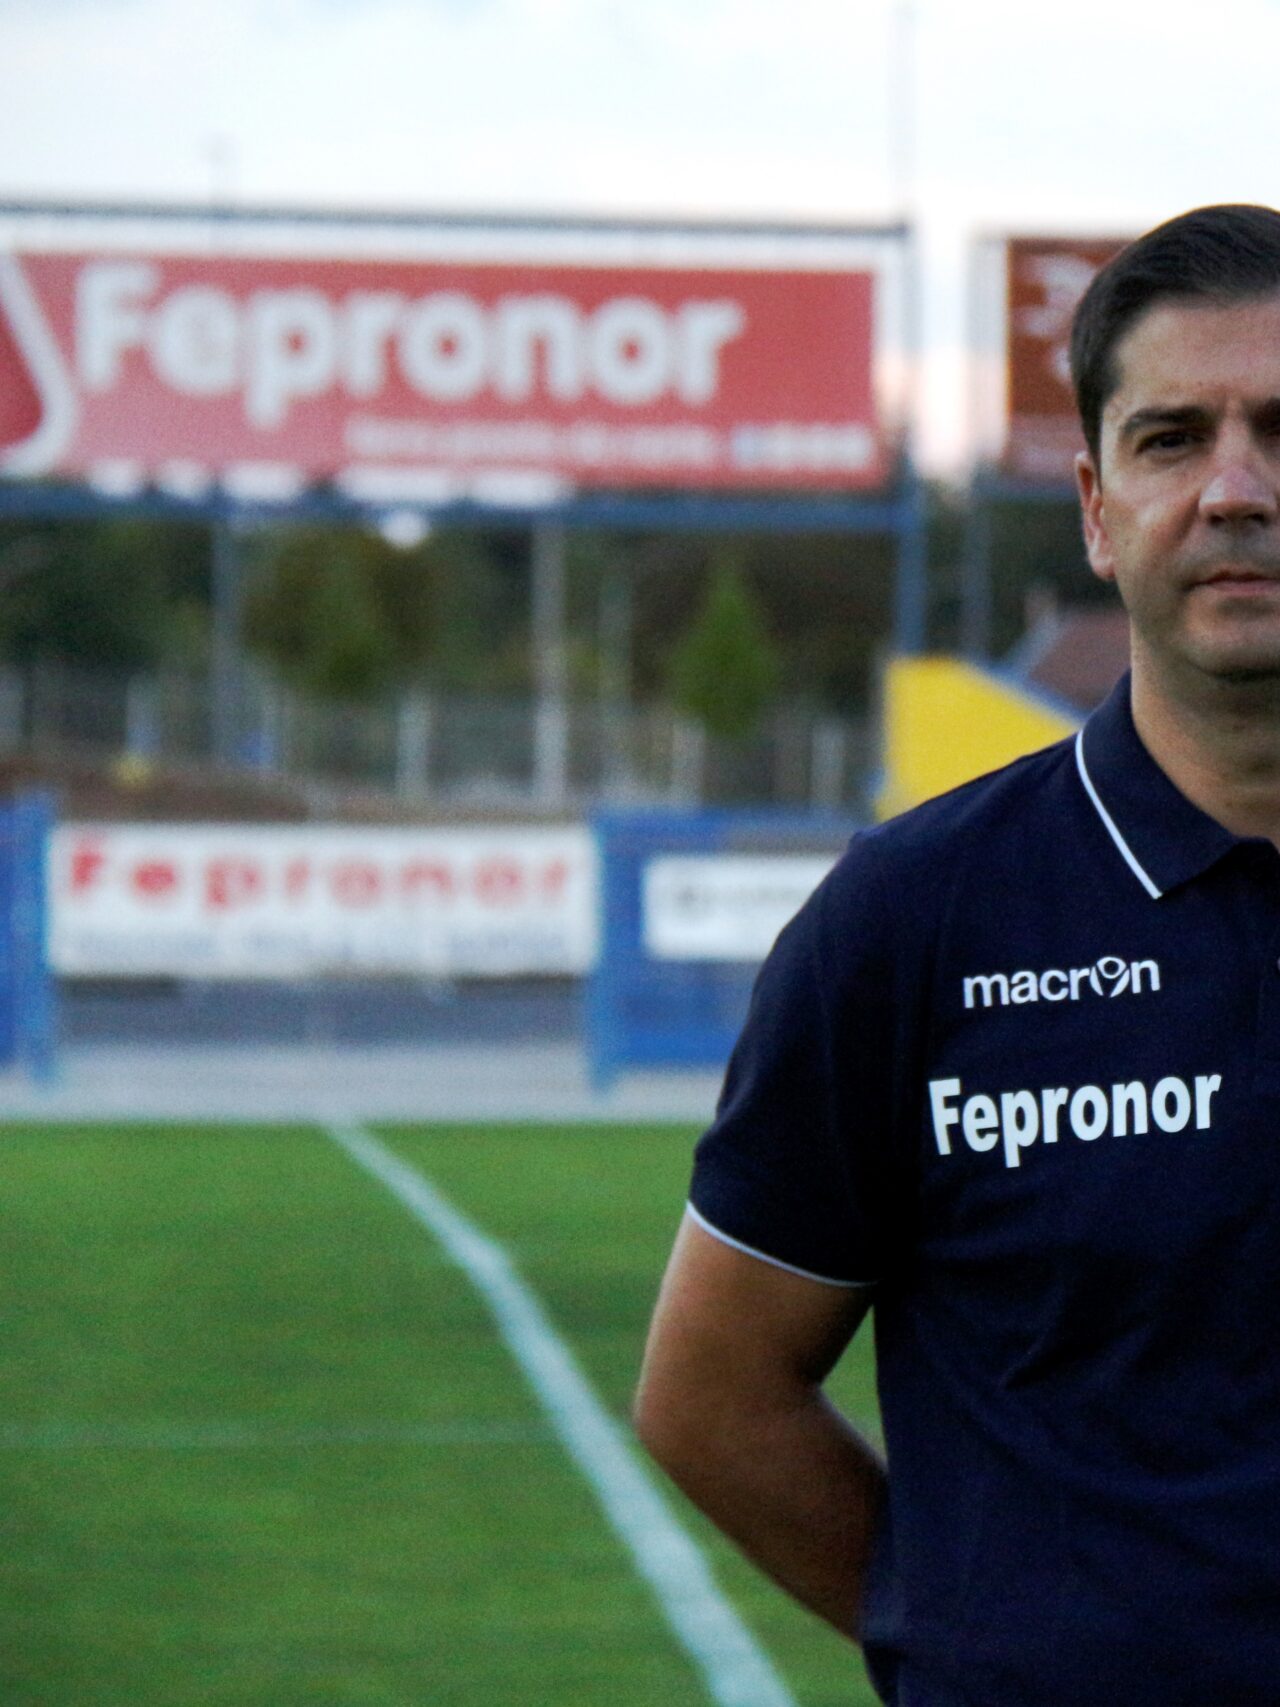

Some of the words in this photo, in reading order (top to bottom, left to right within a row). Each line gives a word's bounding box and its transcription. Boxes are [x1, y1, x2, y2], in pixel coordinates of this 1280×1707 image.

[74, 260, 744, 432] Fepronor
[68, 838, 573, 912] Fepronor
[963, 956, 1160, 1009] macron
[928, 1073, 1222, 1169] Fepronor
